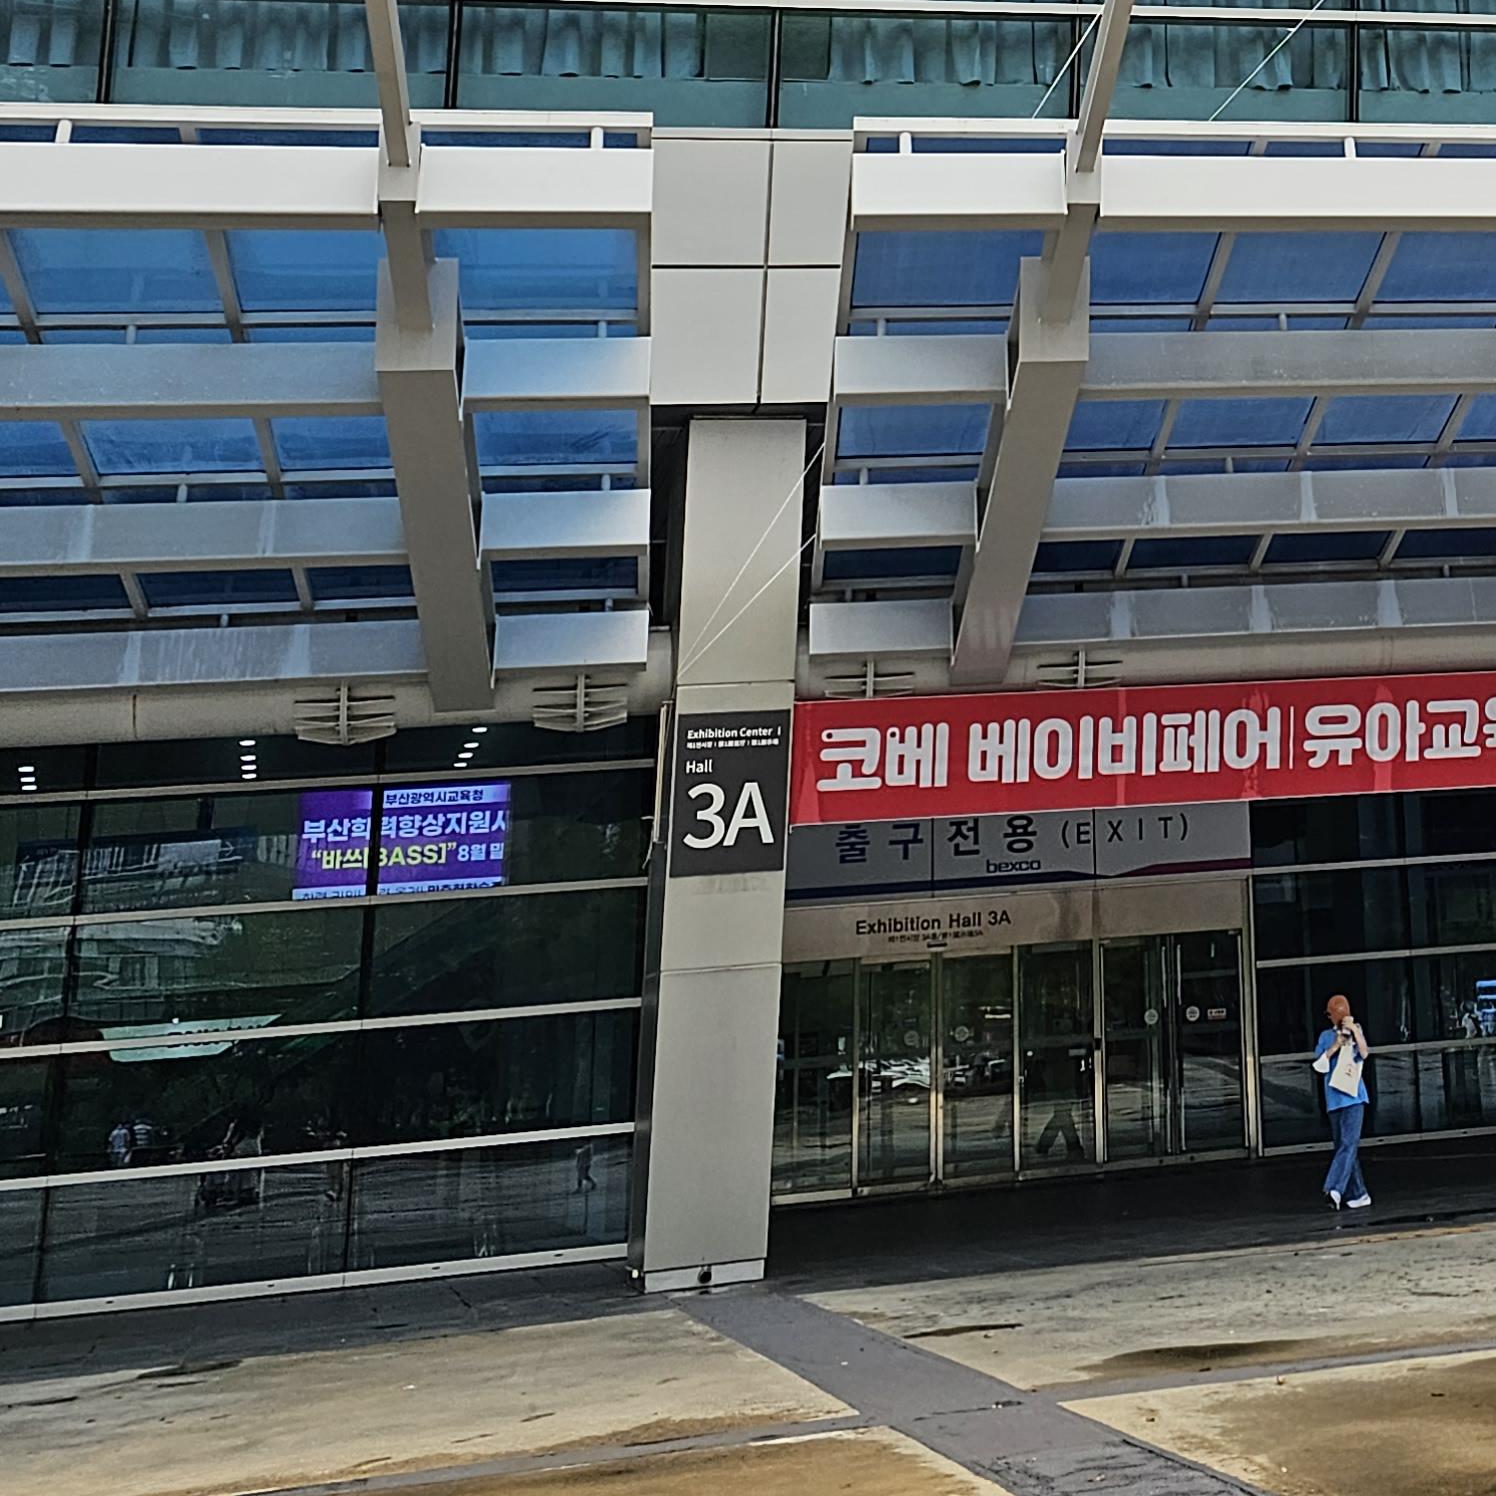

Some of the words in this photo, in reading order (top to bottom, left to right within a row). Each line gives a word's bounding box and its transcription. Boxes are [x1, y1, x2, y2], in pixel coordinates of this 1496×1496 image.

[687, 727, 738, 740] Exhibition
[739, 727, 774, 738] Center
[816, 720, 950, 792] 코베
[967, 705, 1281, 785] 베이비페어
[685, 758, 713, 774] Hall
[384, 789, 484, 806] 부산광역시교육청
[682, 782, 775, 850] 3A
[985, 858, 1042, 874] bexco
[855, 915, 942, 936] Exhibition
[948, 911, 982, 929] Hall
[988, 909, 1012, 926] 3A
